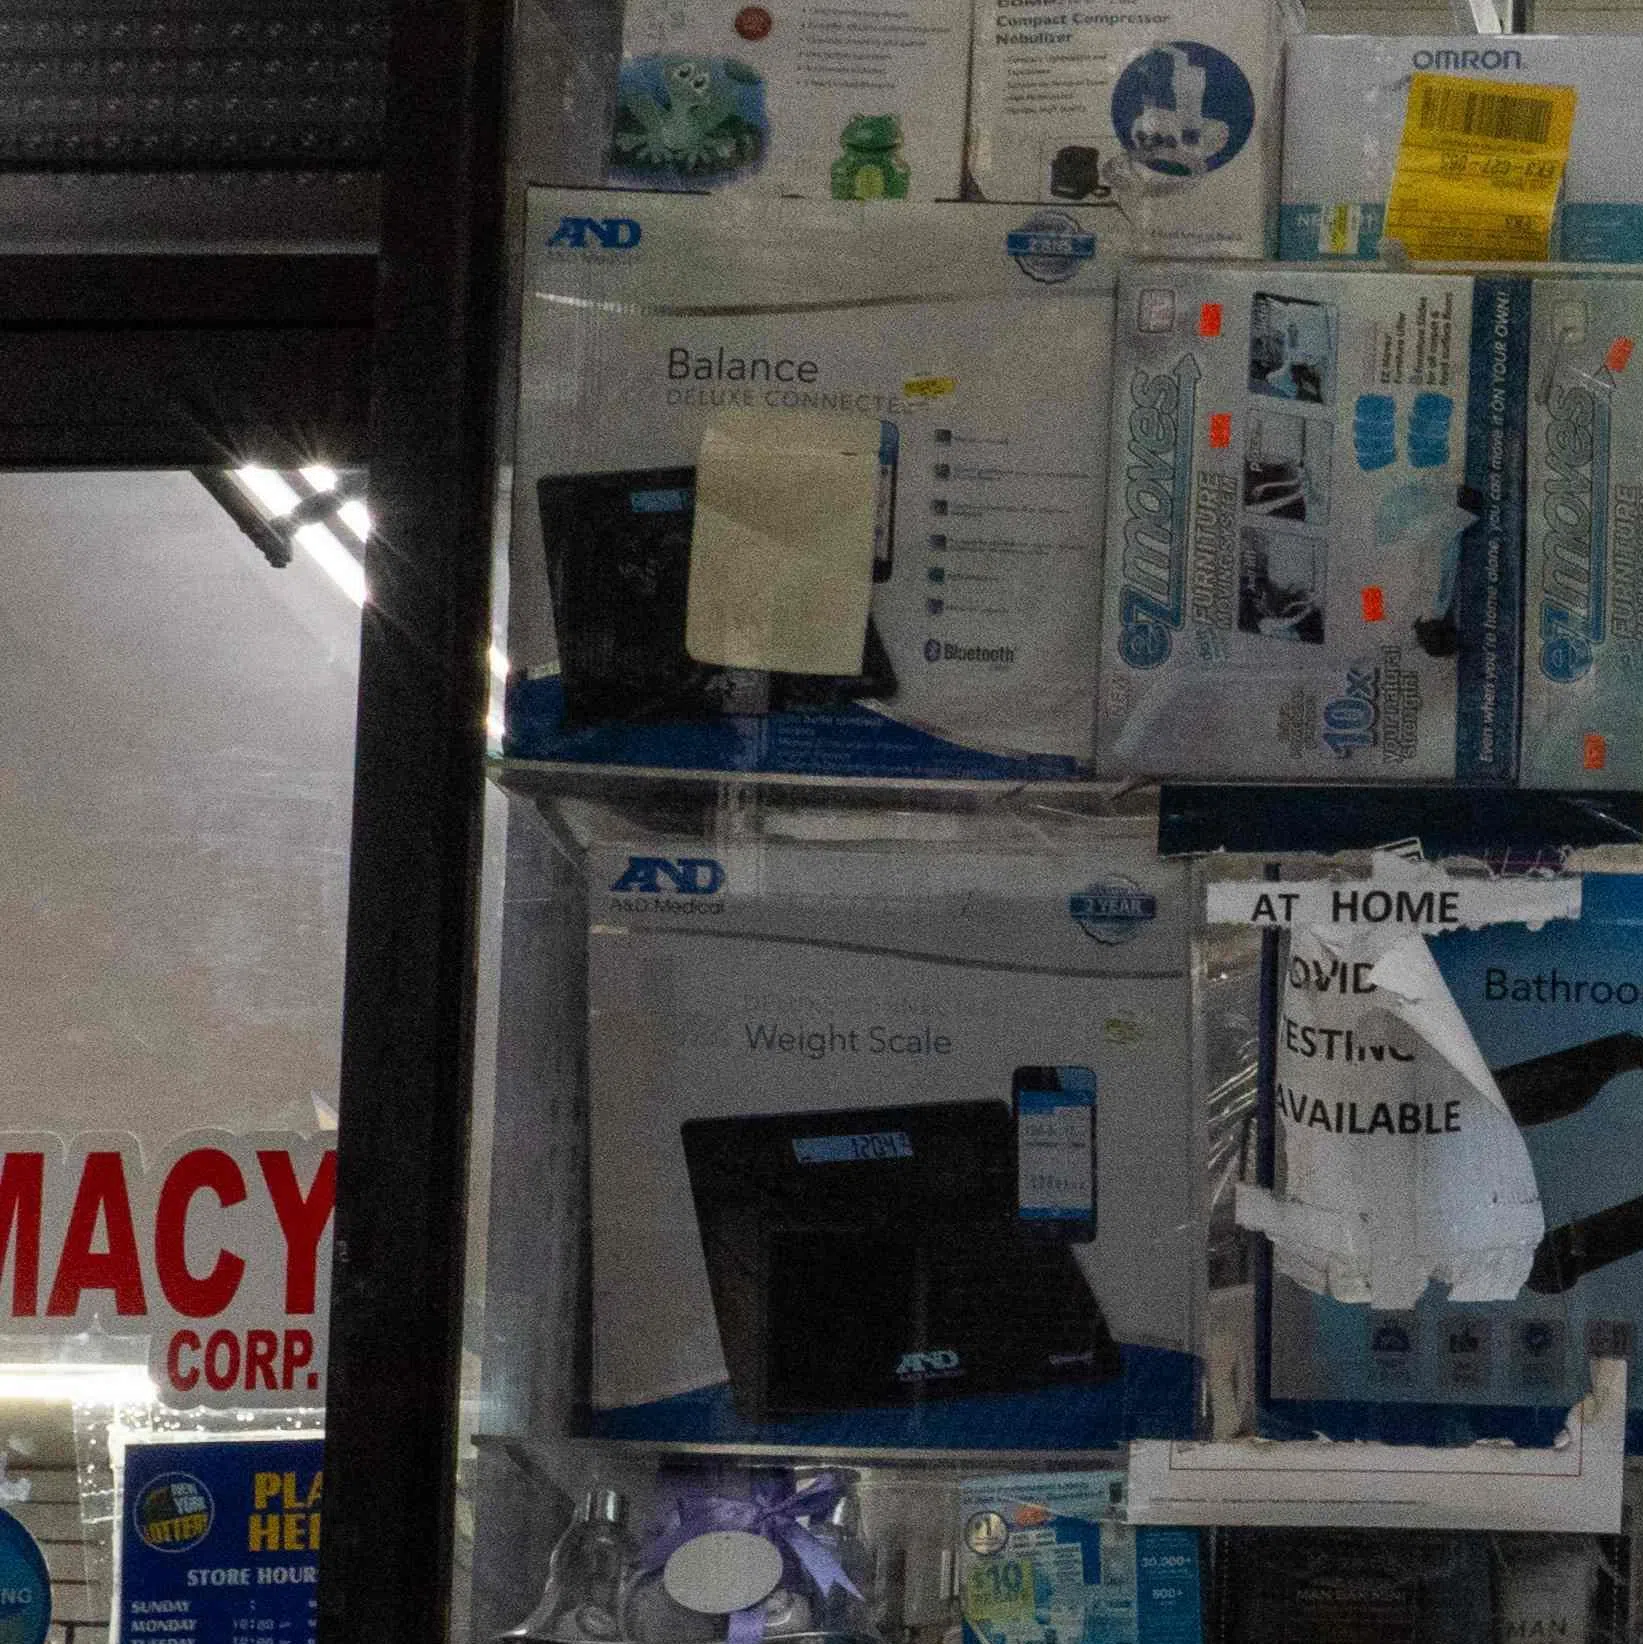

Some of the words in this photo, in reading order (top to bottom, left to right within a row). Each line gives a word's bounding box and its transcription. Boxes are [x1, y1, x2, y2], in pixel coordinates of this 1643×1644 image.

[996, 14, 1061, 29] Compact
[1066, 12, 1171, 27] Compressor
[996, 30, 1072, 45] Nebulizer
[1413, 49, 1522, 70] OMRON
[1495, 291, 1511, 337] OWN!
[668, 348, 819, 384] Balance
[1493, 340, 1509, 385] YOUR
[1491, 388, 1506, 410] ON
[1192, 472, 1219, 626] FURNITURE
[1611, 485, 1638, 640] FURNITURE
[943, 643, 1015, 664] Bluetooth
[1321, 667, 1379, 758] 10x
[1480, 683, 1497, 725] when
[610, 856, 725, 895] AND
[1251, 893, 1299, 922] AT
[1331, 890, 1460, 924] HOME
[745, 1023, 859, 1060] Weight
[869, 1026, 953, 1056] Scale
[1274, 1083, 1461, 1135] AVAILABLE
[167, 1328, 319, 1391] CORP.
[254, 1471, 327, 1511] PLA
[186, 1568, 250, 1588] STORE
[257, 1565, 318, 1585] HOUR
[130, 1600, 191, 1613] SUNDAY
[130, 1619, 197, 1632] MONDAY
